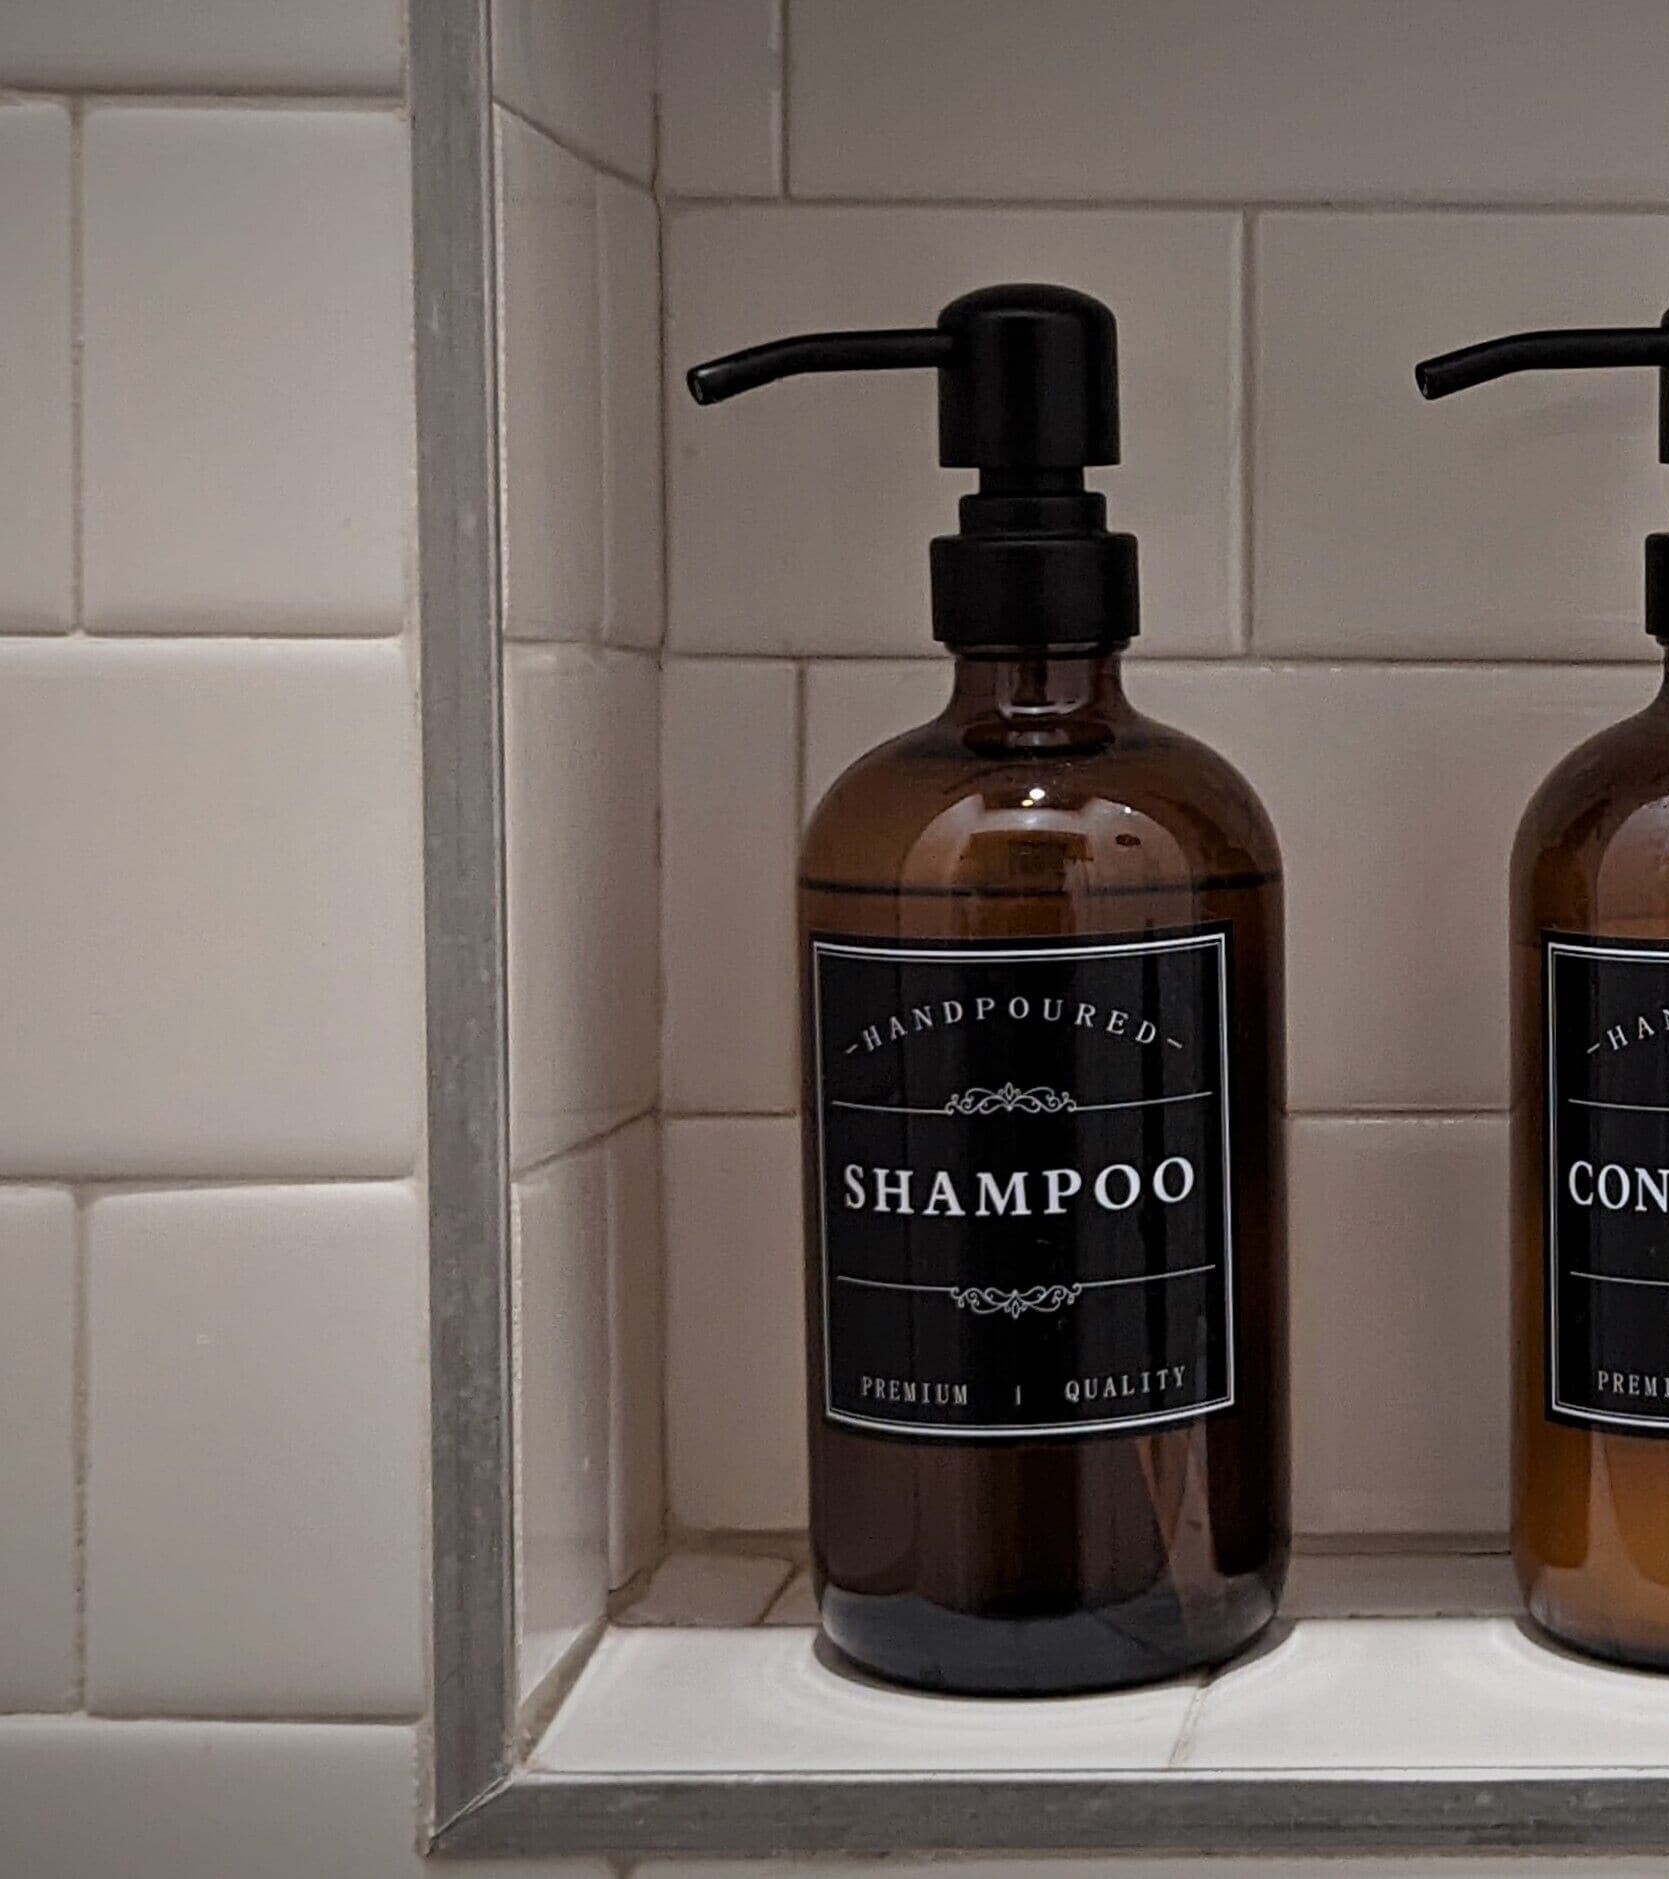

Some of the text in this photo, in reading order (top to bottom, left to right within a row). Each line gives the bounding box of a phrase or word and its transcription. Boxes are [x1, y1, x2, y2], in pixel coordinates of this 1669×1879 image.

[845, 1156, 1195, 1217] SHAMPOO
[862, 1376, 967, 1405] PREMIUM
[1065, 1366, 1186, 1402] QUALITY
